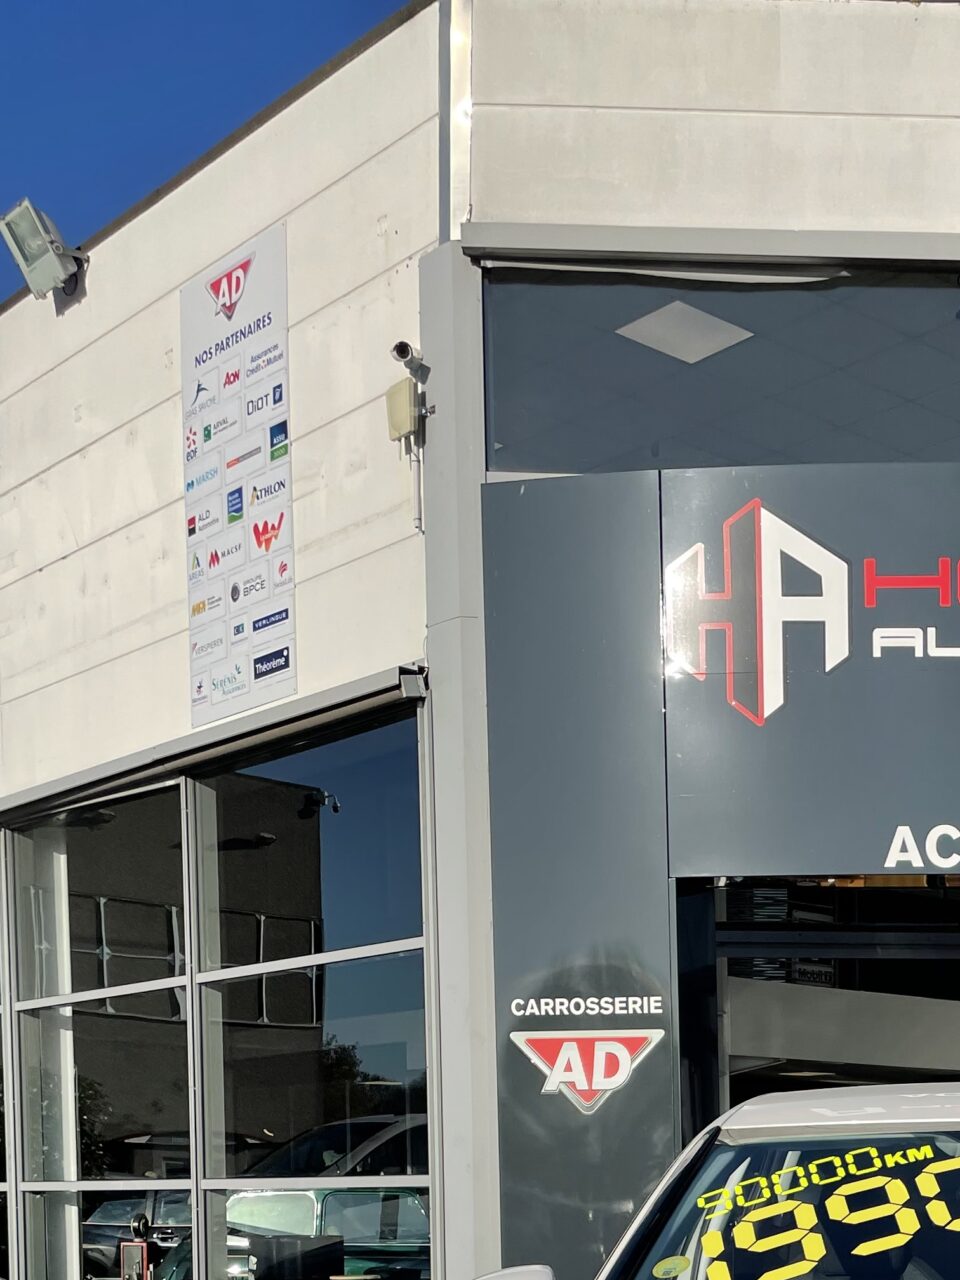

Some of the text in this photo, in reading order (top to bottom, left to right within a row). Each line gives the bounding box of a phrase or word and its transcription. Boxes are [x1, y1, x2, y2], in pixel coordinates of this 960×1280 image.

[215, 268, 245, 316] AD
[194, 312, 272, 368] NOS PARTENAIRES
[198, 509, 211, 522] ALD
[220, 543, 242, 558] MACSF
[243, 579, 266, 597] BPCE
[255, 611, 287, 628] VERLINGUE
[510, 996, 663, 1016] CARROSSERIE
[541, 1041, 632, 1094] AD
